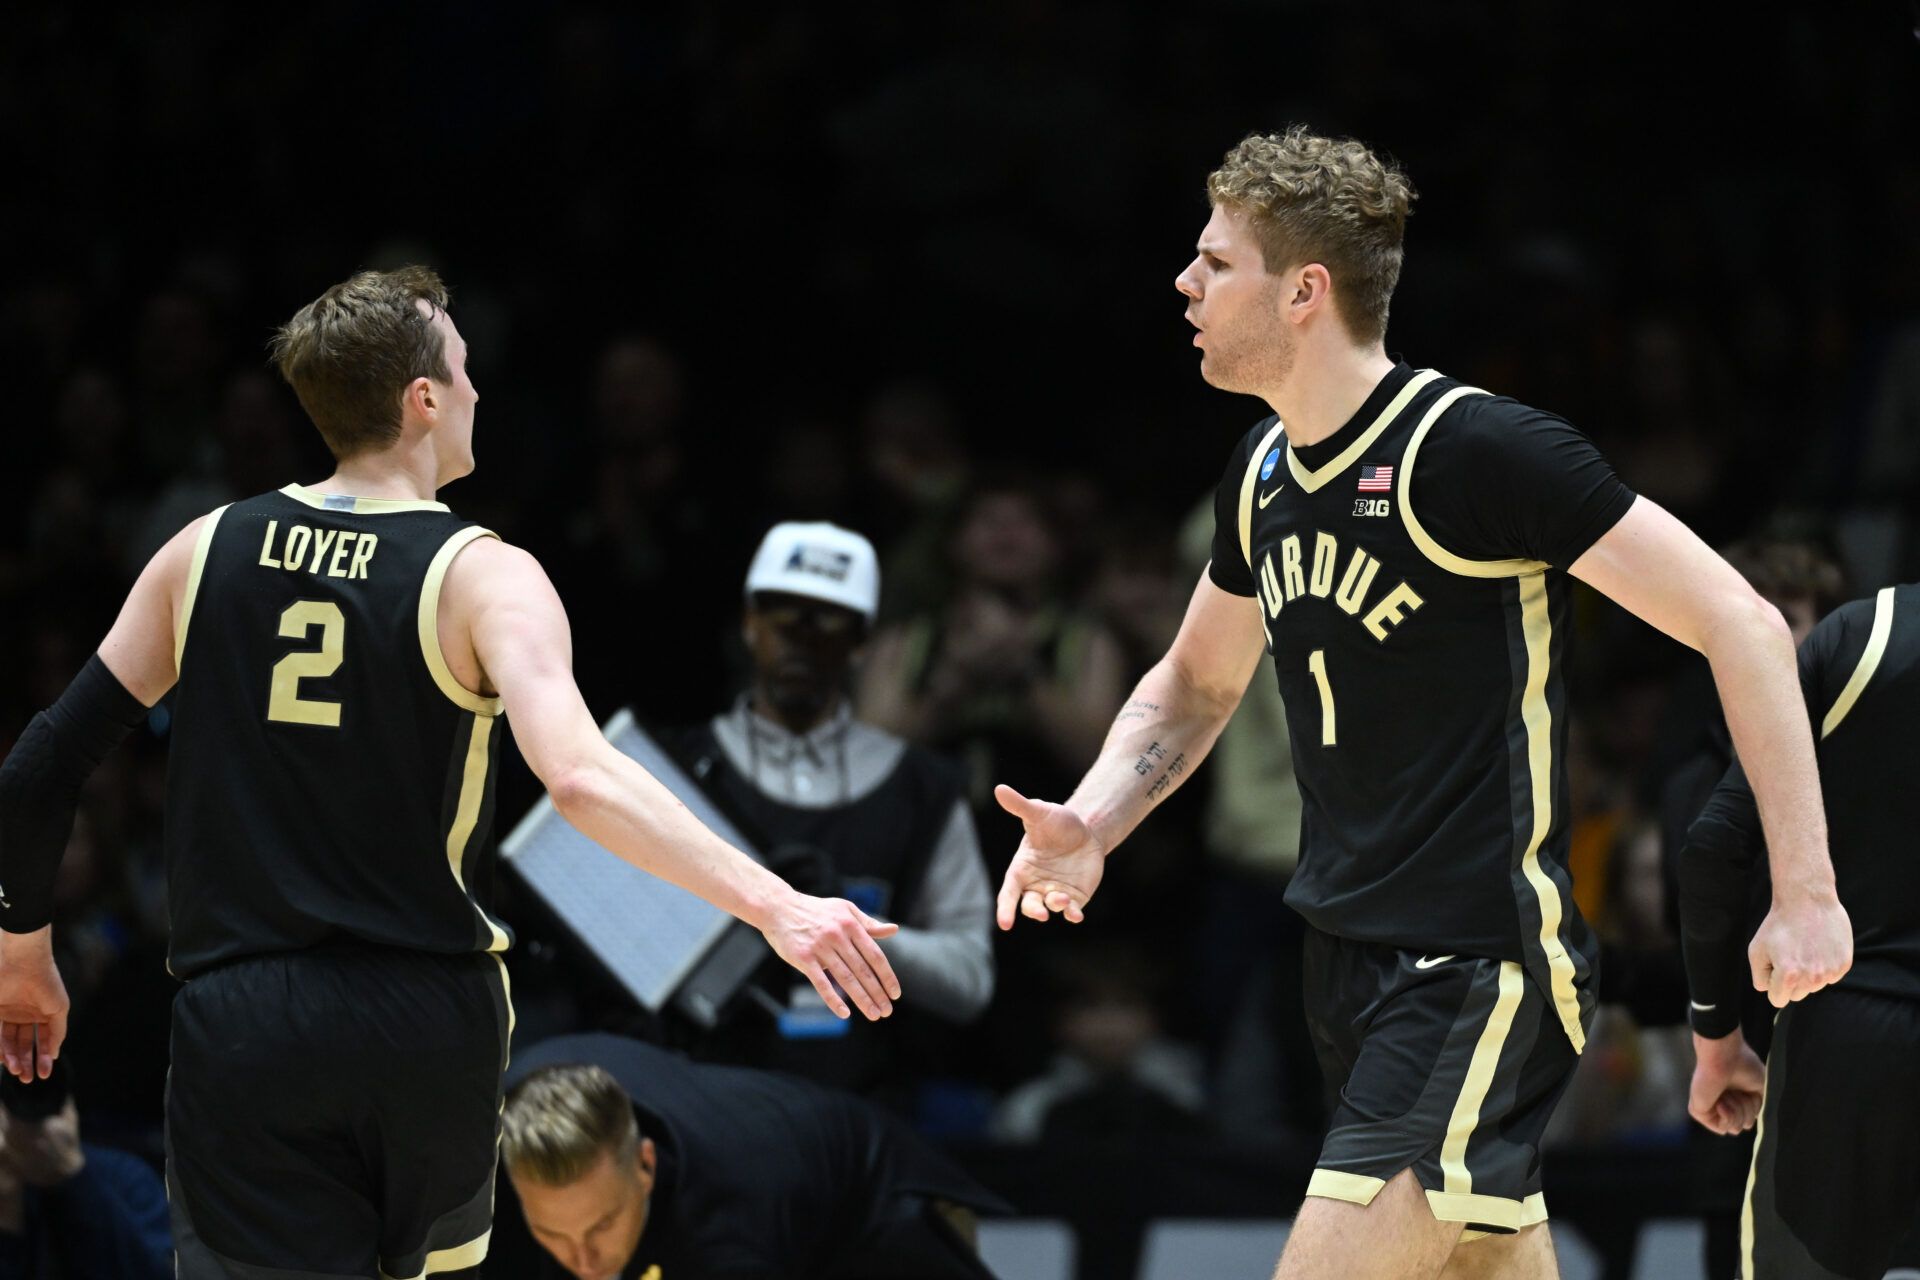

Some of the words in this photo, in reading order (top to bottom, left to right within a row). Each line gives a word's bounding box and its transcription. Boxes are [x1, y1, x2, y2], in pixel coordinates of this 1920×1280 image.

[258, 520, 379, 580] LOYER
[1257, 529, 1426, 648] URDUE
[267, 600, 345, 727] 2
[1308, 650, 1336, 746] 1
